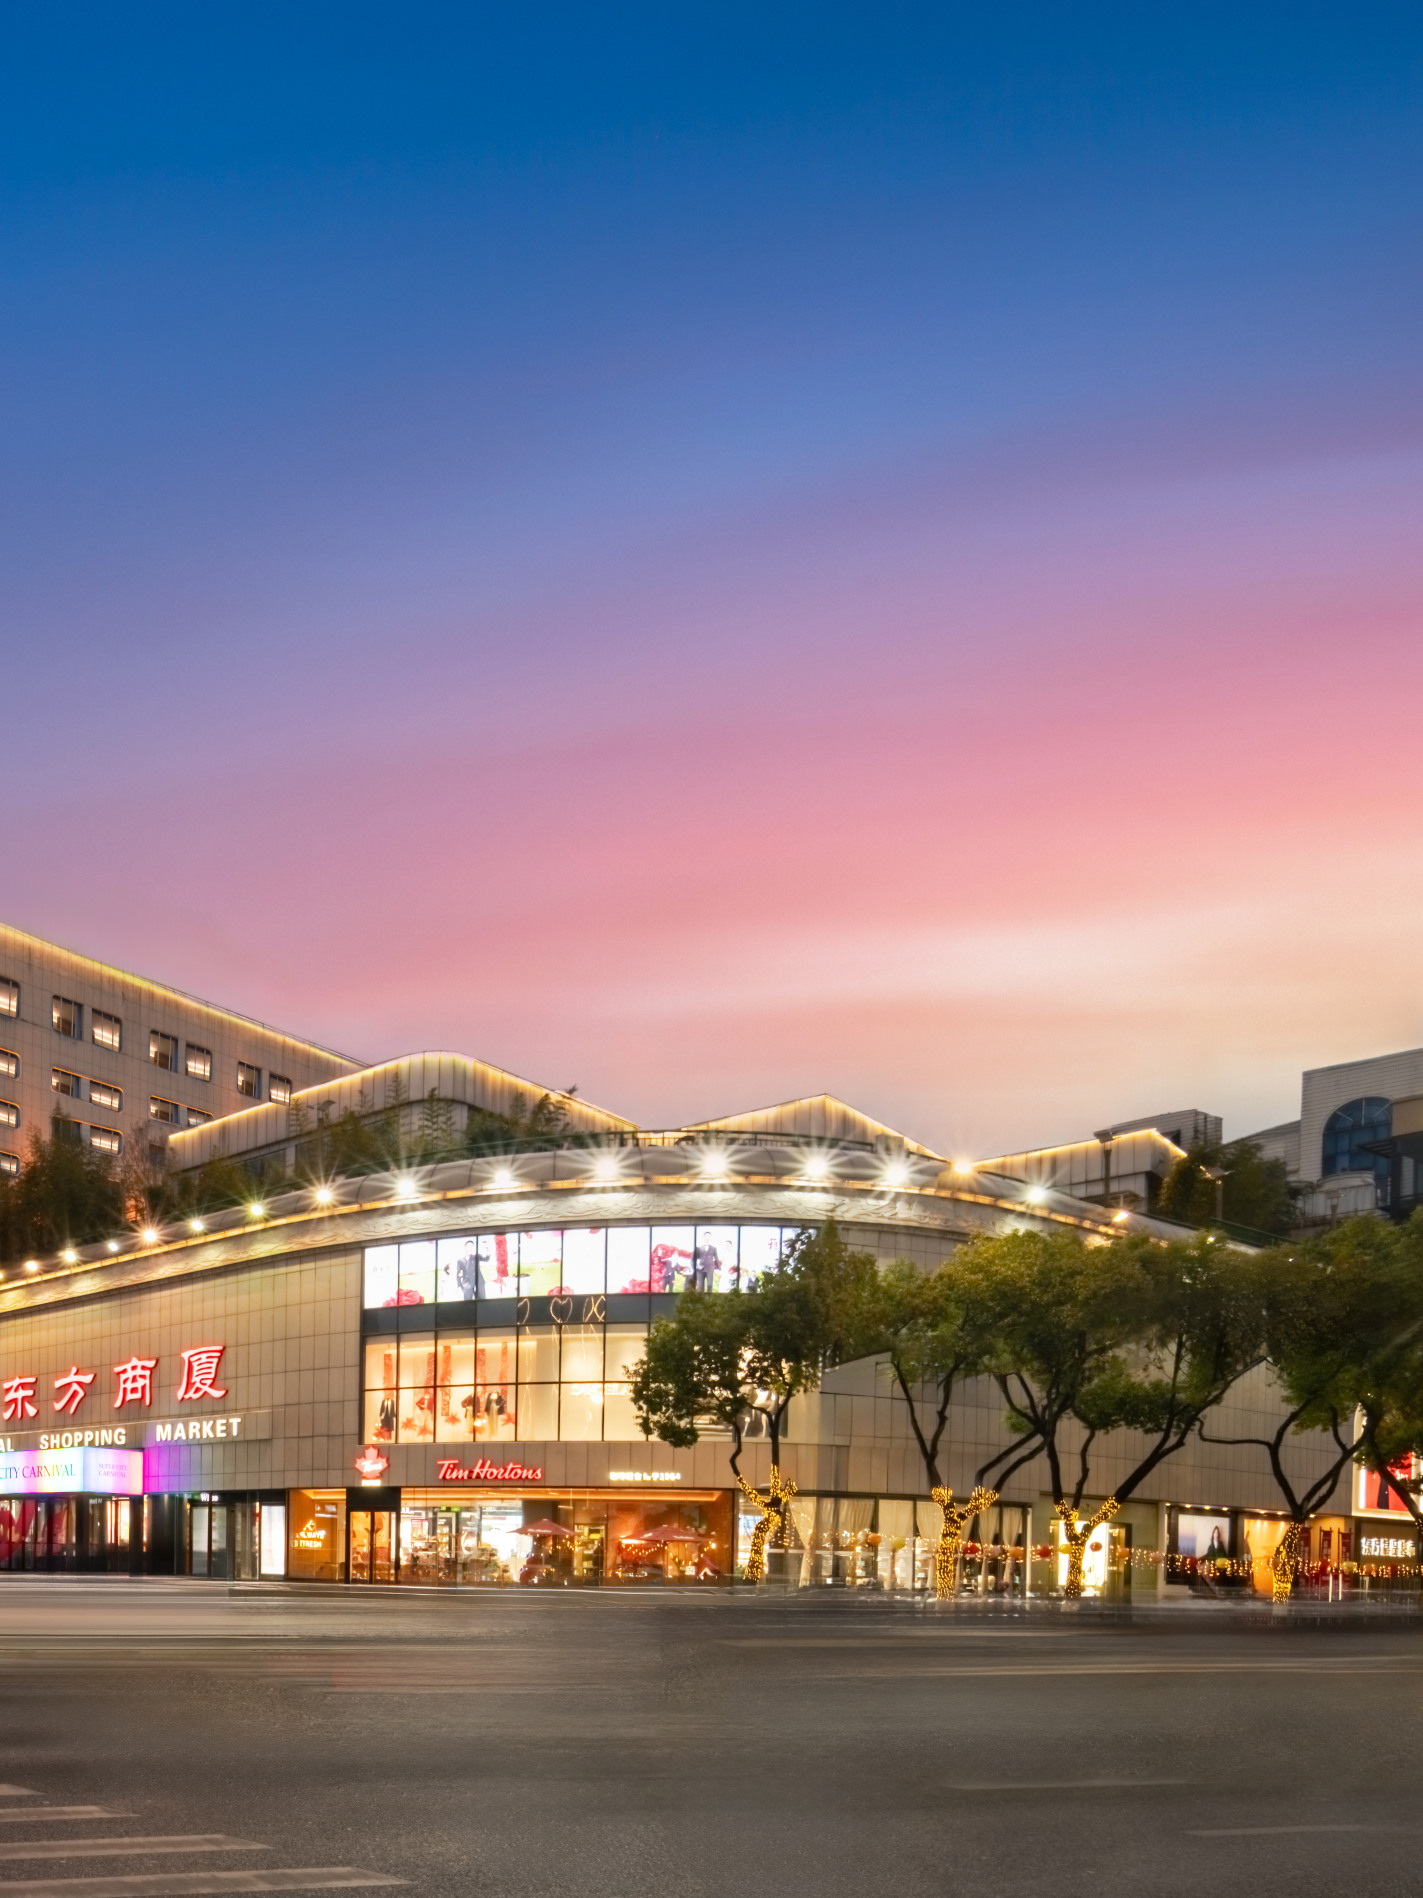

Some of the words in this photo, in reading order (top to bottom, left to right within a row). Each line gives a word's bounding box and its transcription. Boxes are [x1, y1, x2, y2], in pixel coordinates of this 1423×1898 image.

[1, 1344, 229, 1421] 东方商厦
[39, 1427, 127, 1450] SHOPPING
[155, 1417, 243, 1442] MARKET
[22, 1463, 77, 1479] CARNIVAL
[437, 1460, 468, 1480] Tim
[472, 1458, 543, 1480] Hortons
